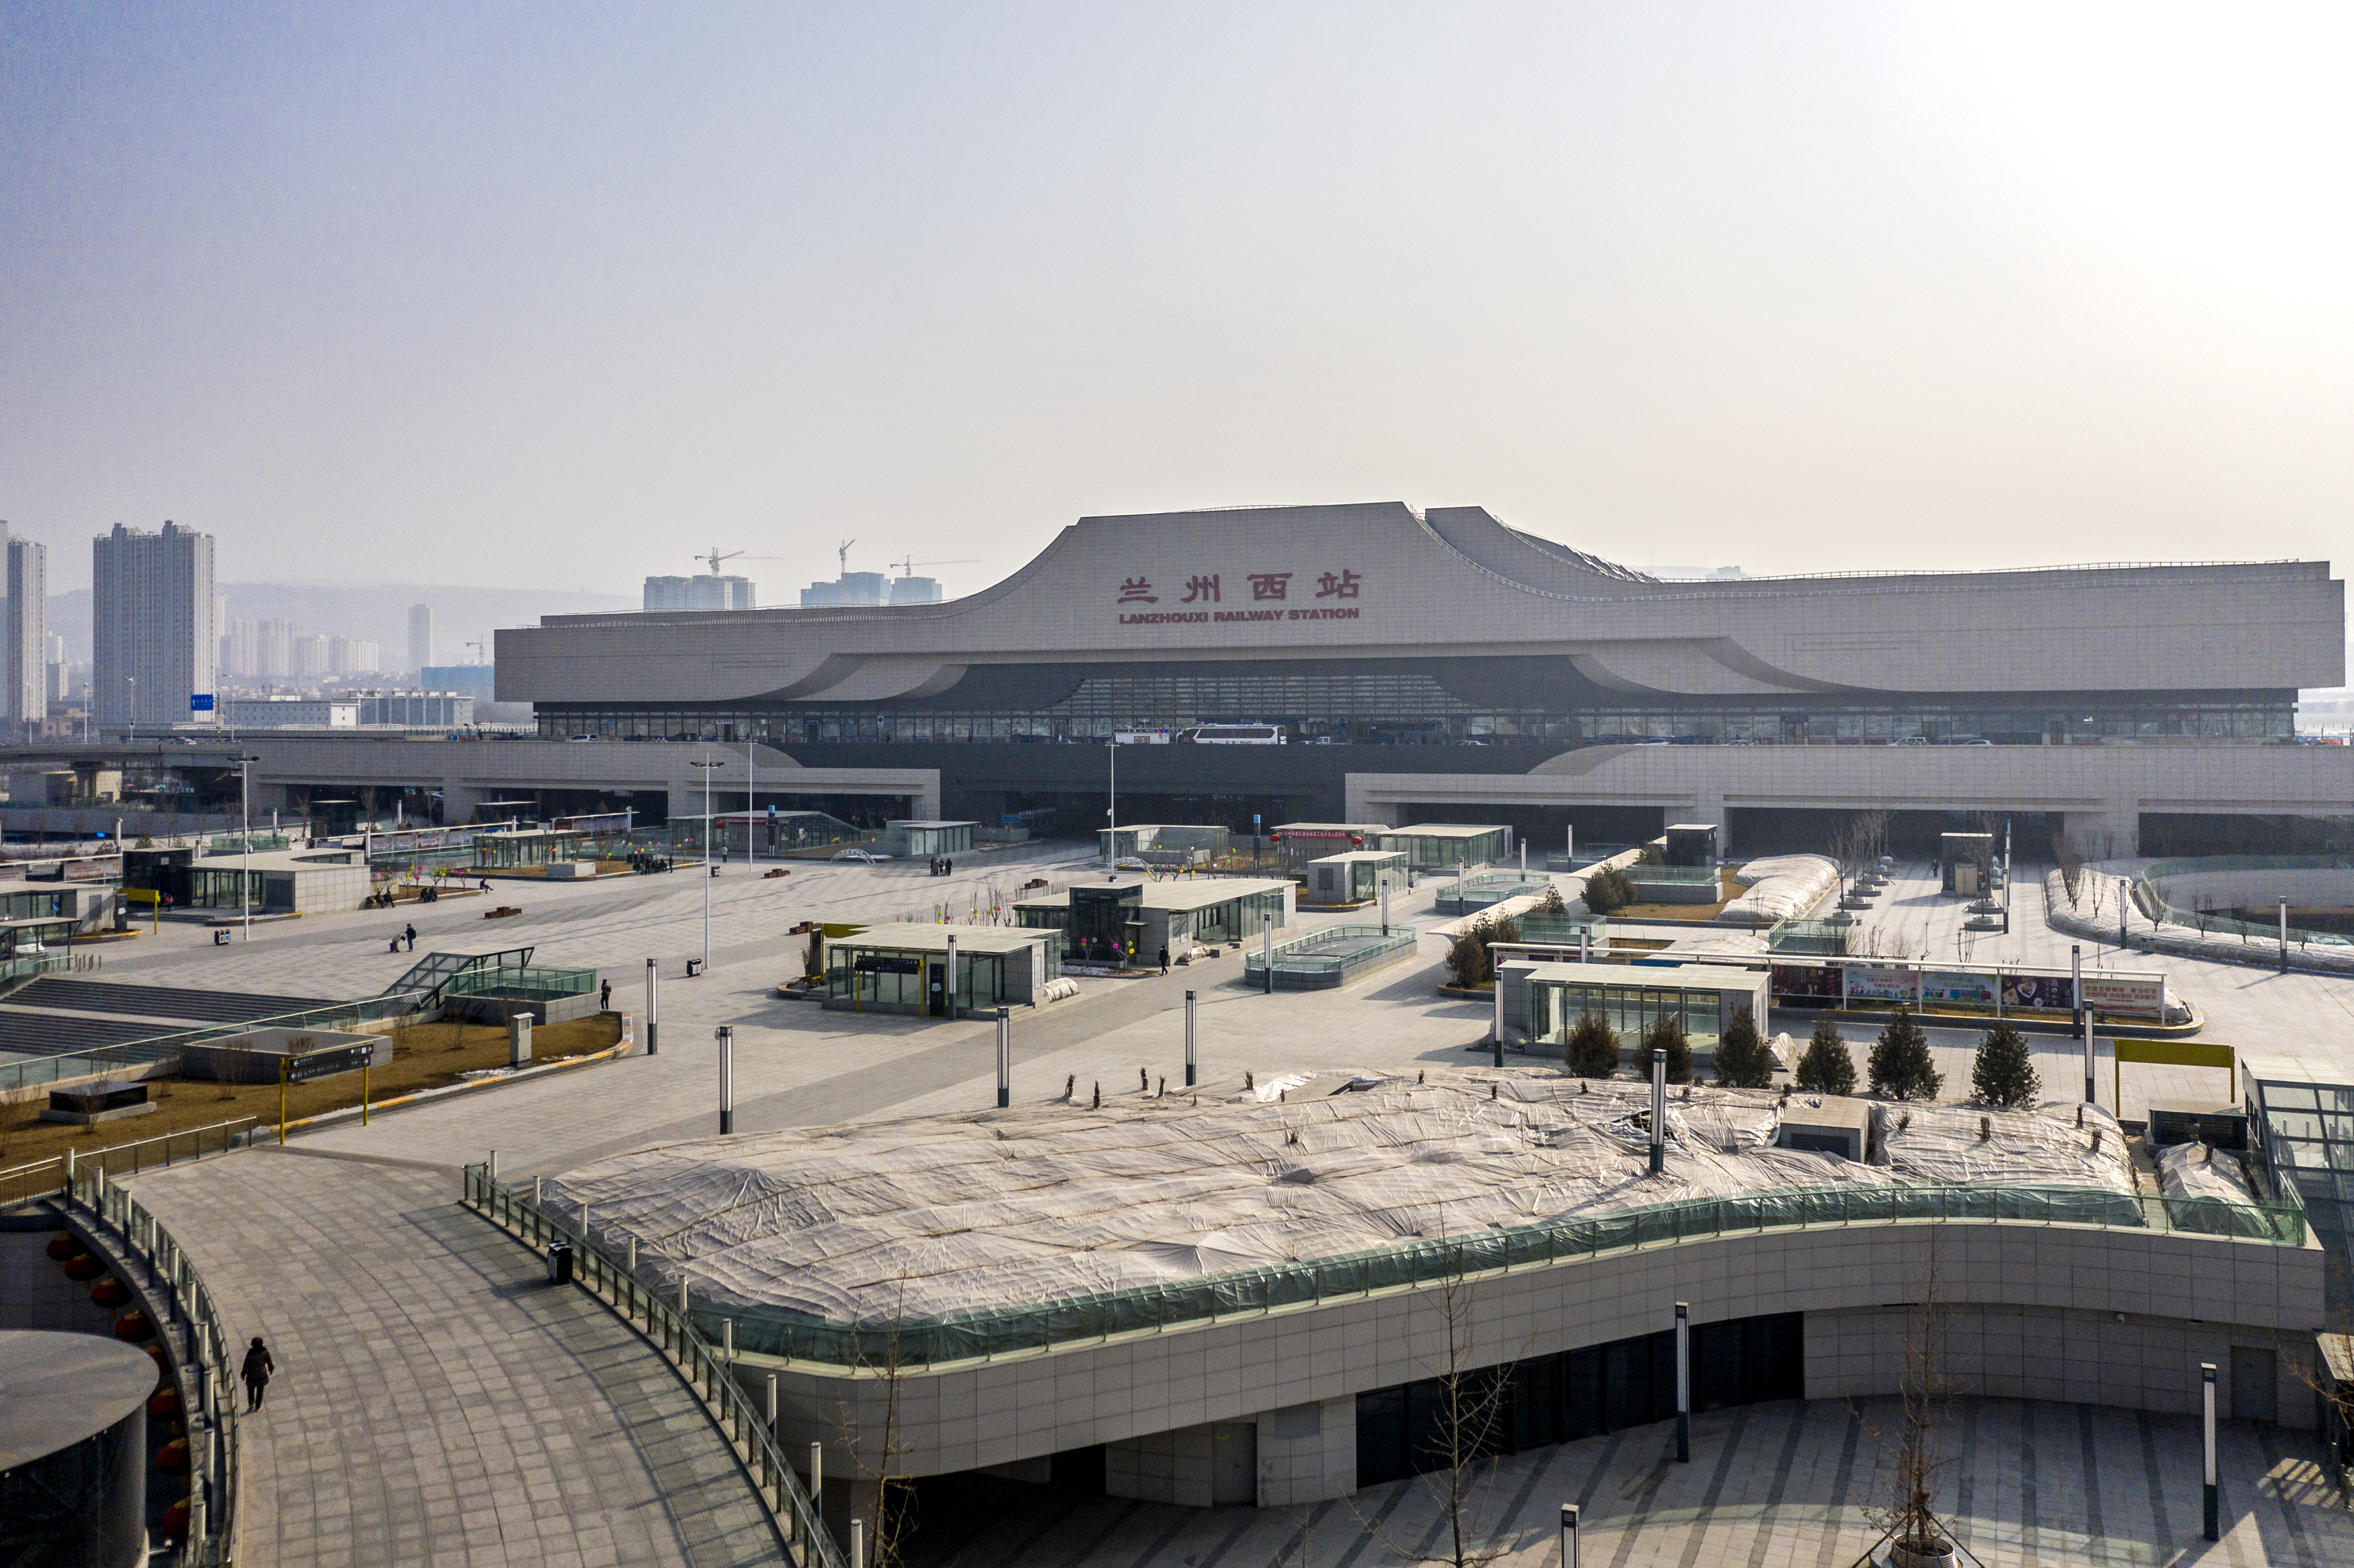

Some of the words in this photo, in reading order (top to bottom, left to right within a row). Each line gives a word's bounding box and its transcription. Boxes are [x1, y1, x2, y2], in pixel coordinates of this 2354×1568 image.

[1118, 569, 1361, 604] 兰州西站
[1120, 612, 1208, 624] LANZHOUXI
[1214, 610, 1284, 622] RAILWAY
[1288, 608, 1359, 620] STATION
